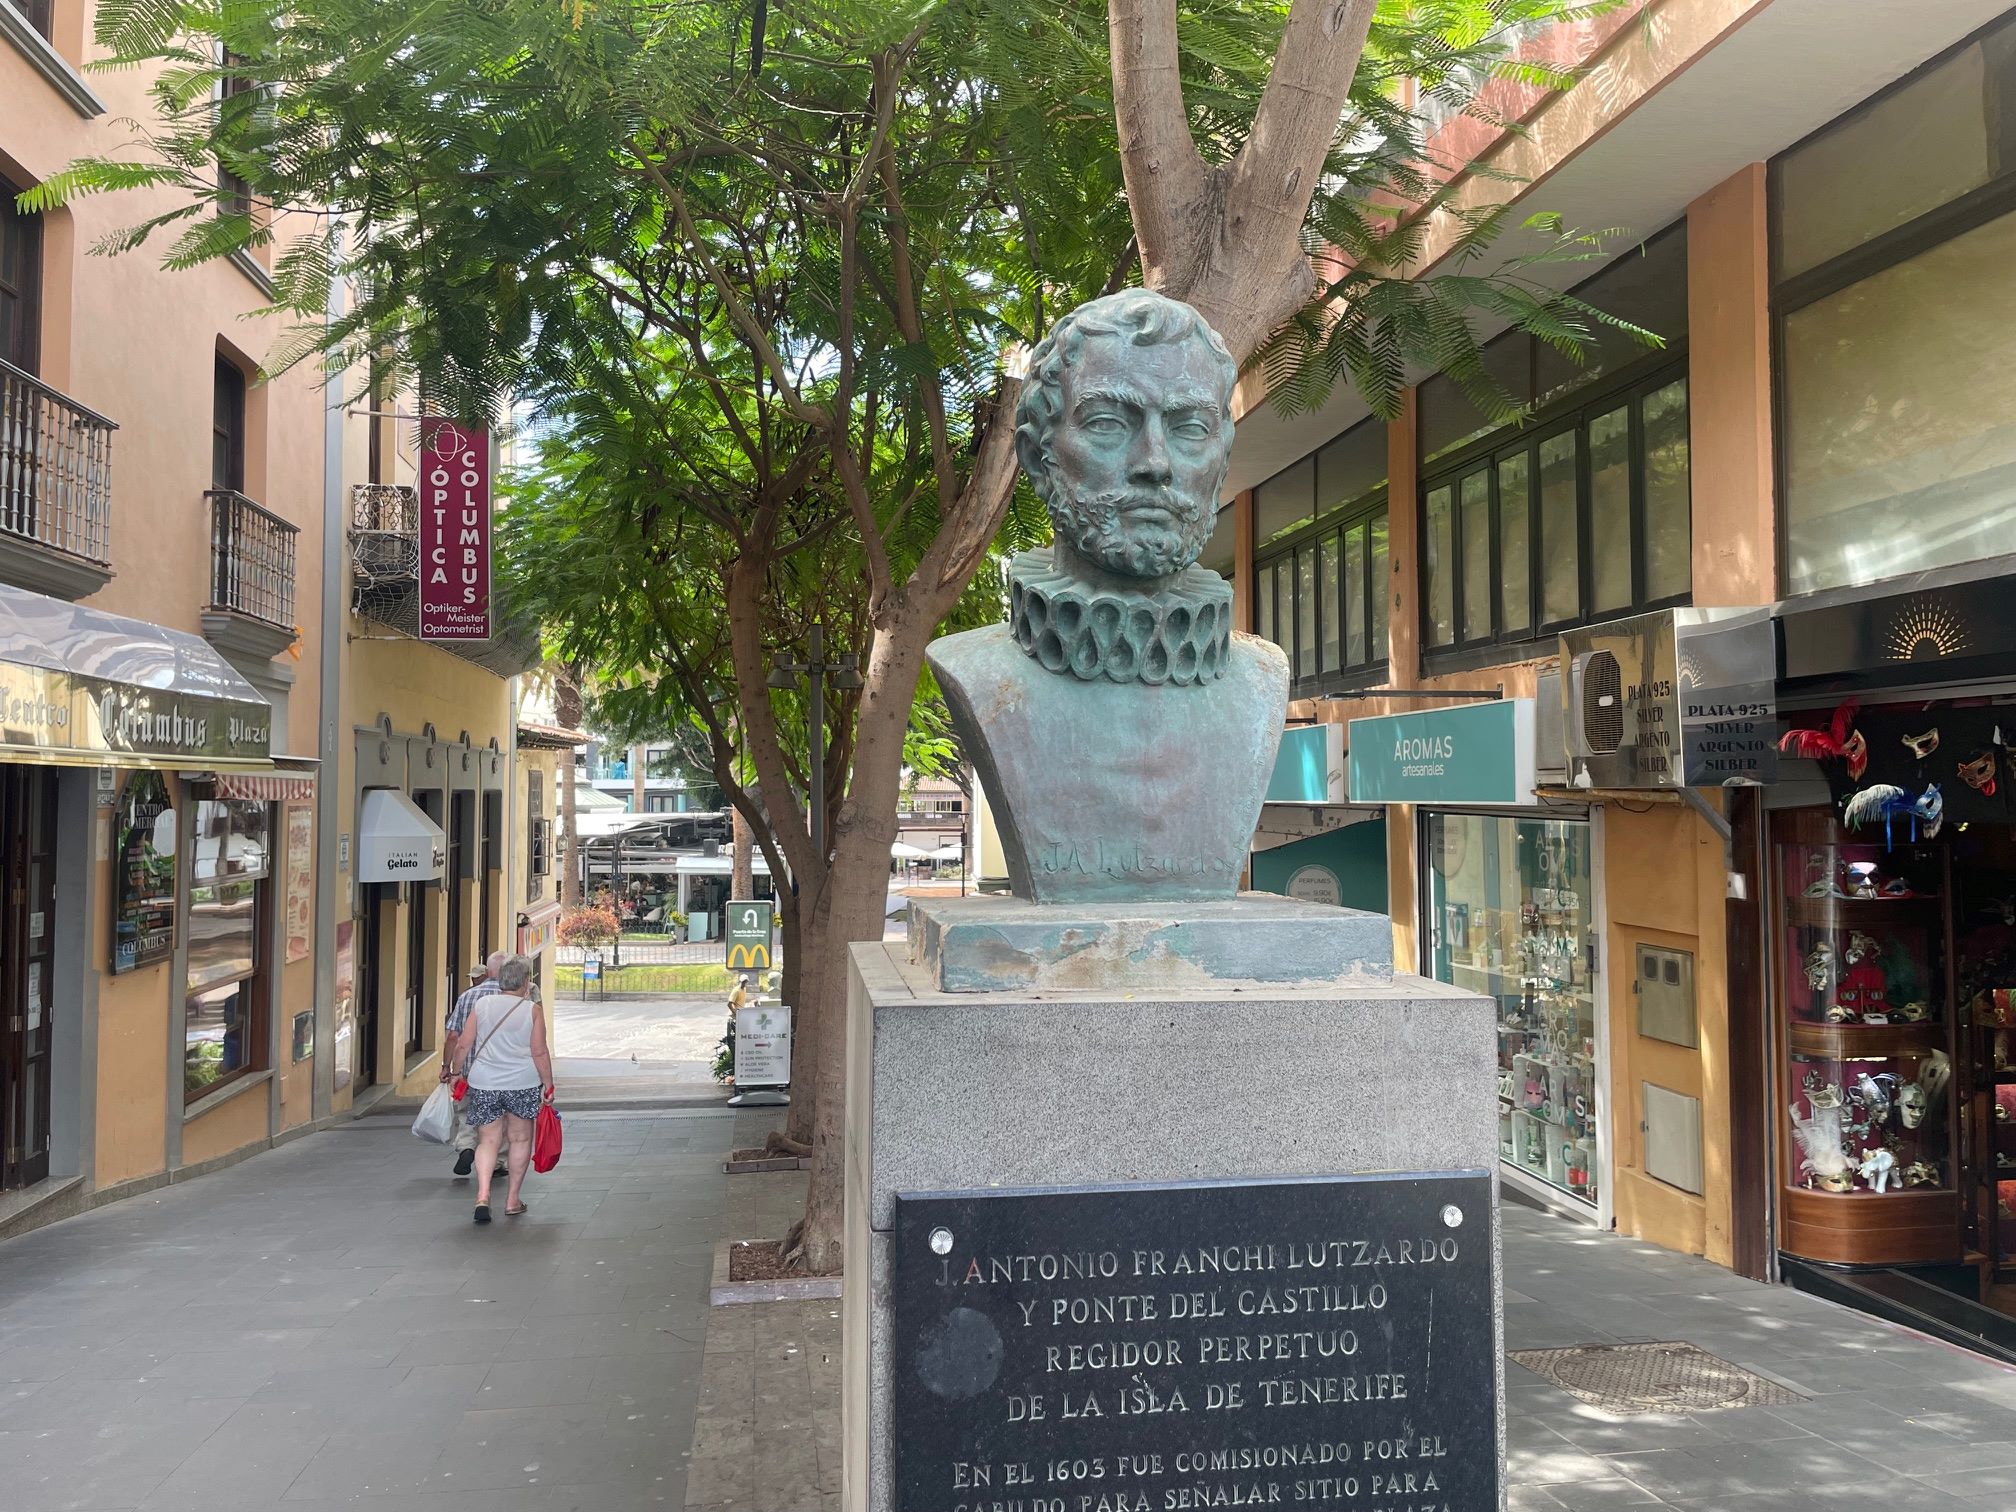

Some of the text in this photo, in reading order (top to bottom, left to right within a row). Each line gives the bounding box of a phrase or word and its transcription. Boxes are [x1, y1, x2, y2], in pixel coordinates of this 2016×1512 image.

[430, 464, 450, 584] ÓPTICA
[459, 450, 481, 604] COLUMBUS
[423, 602, 466, 614] Optiker-
[446, 613, 486, 624] Meister
[423, 623, 485, 635] Optometrist
[1628, 680, 1671, 701] PLATA 925
[99, 688, 208, 749] Columbus
[229, 715, 269, 747] Plaza
[1637, 706, 1664, 723] SILVER
[1688, 703, 1769, 717] PLATA 925
[1704, 722, 1755, 735] SILVER
[1394, 735, 1453, 761] AROMAS
[1634, 730, 1671, 748] ARGENTO
[1696, 740, 1764, 753] ARGENTO
[1402, 761, 1445, 777] artesanales
[1640, 756, 1668, 773] SILBER
[1705, 758, 1757, 771] SILBER
[387, 859, 418, 871] Gelato
[122, 935, 167, 956] COLUMBUS
[1132, 1244, 1276, 1277] FRANCHI
[1287, 1237, 1460, 1270] LUTZARDO
[1016, 1284, 1388, 1327] Y PONTE DEL CASTILLO
[1046, 1329, 1360, 1373] REGIDOR PERPETUO
[1006, 1373, 1408, 1423] DE LA ISLA DE TENERIFE
[952, 1435, 1448, 1489] EN EL 1603 FUE COMISIONADO POR EL
[1080, 1489, 1153, 1512] PARA
[1164, 1480, 1282, 1511] SEÑALAR
[1294, 1476, 1360, 1501] SITIO
[1371, 1469, 1441, 1495] PARA
